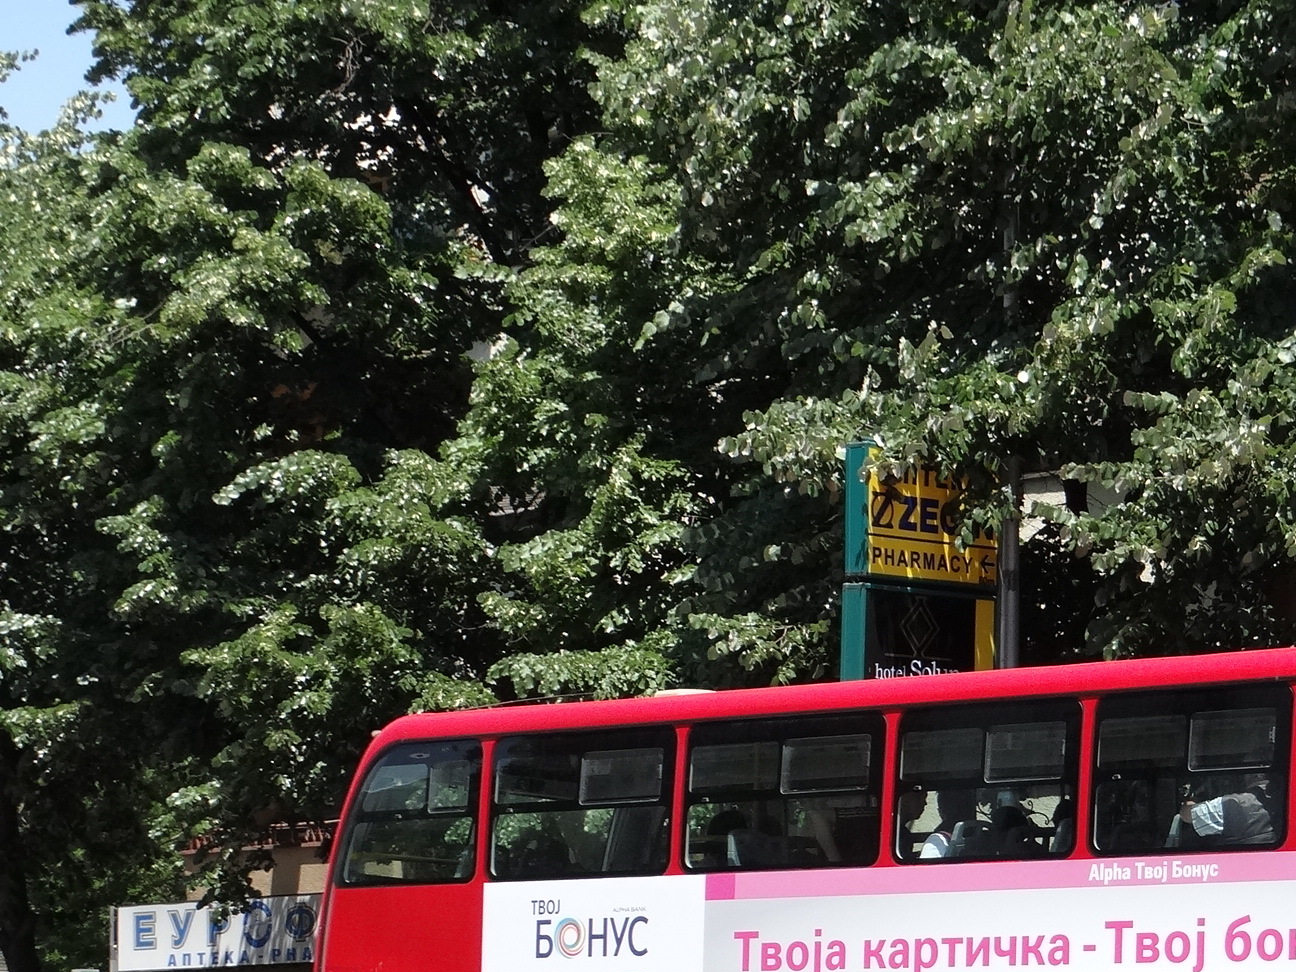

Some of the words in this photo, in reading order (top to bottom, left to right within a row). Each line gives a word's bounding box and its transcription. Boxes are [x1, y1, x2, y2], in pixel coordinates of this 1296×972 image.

[872, 547, 973, 574] PHARMACY
[1088, 862, 1131, 885] Alpha
[1135, 861, 1168, 883] Твој
[1171, 860, 1219, 881] Бонус
[531, 899, 561, 915] ТВОЈ
[535, 915, 649, 959] БОНУС
[168, 951, 250, 967] АПТЕКА
